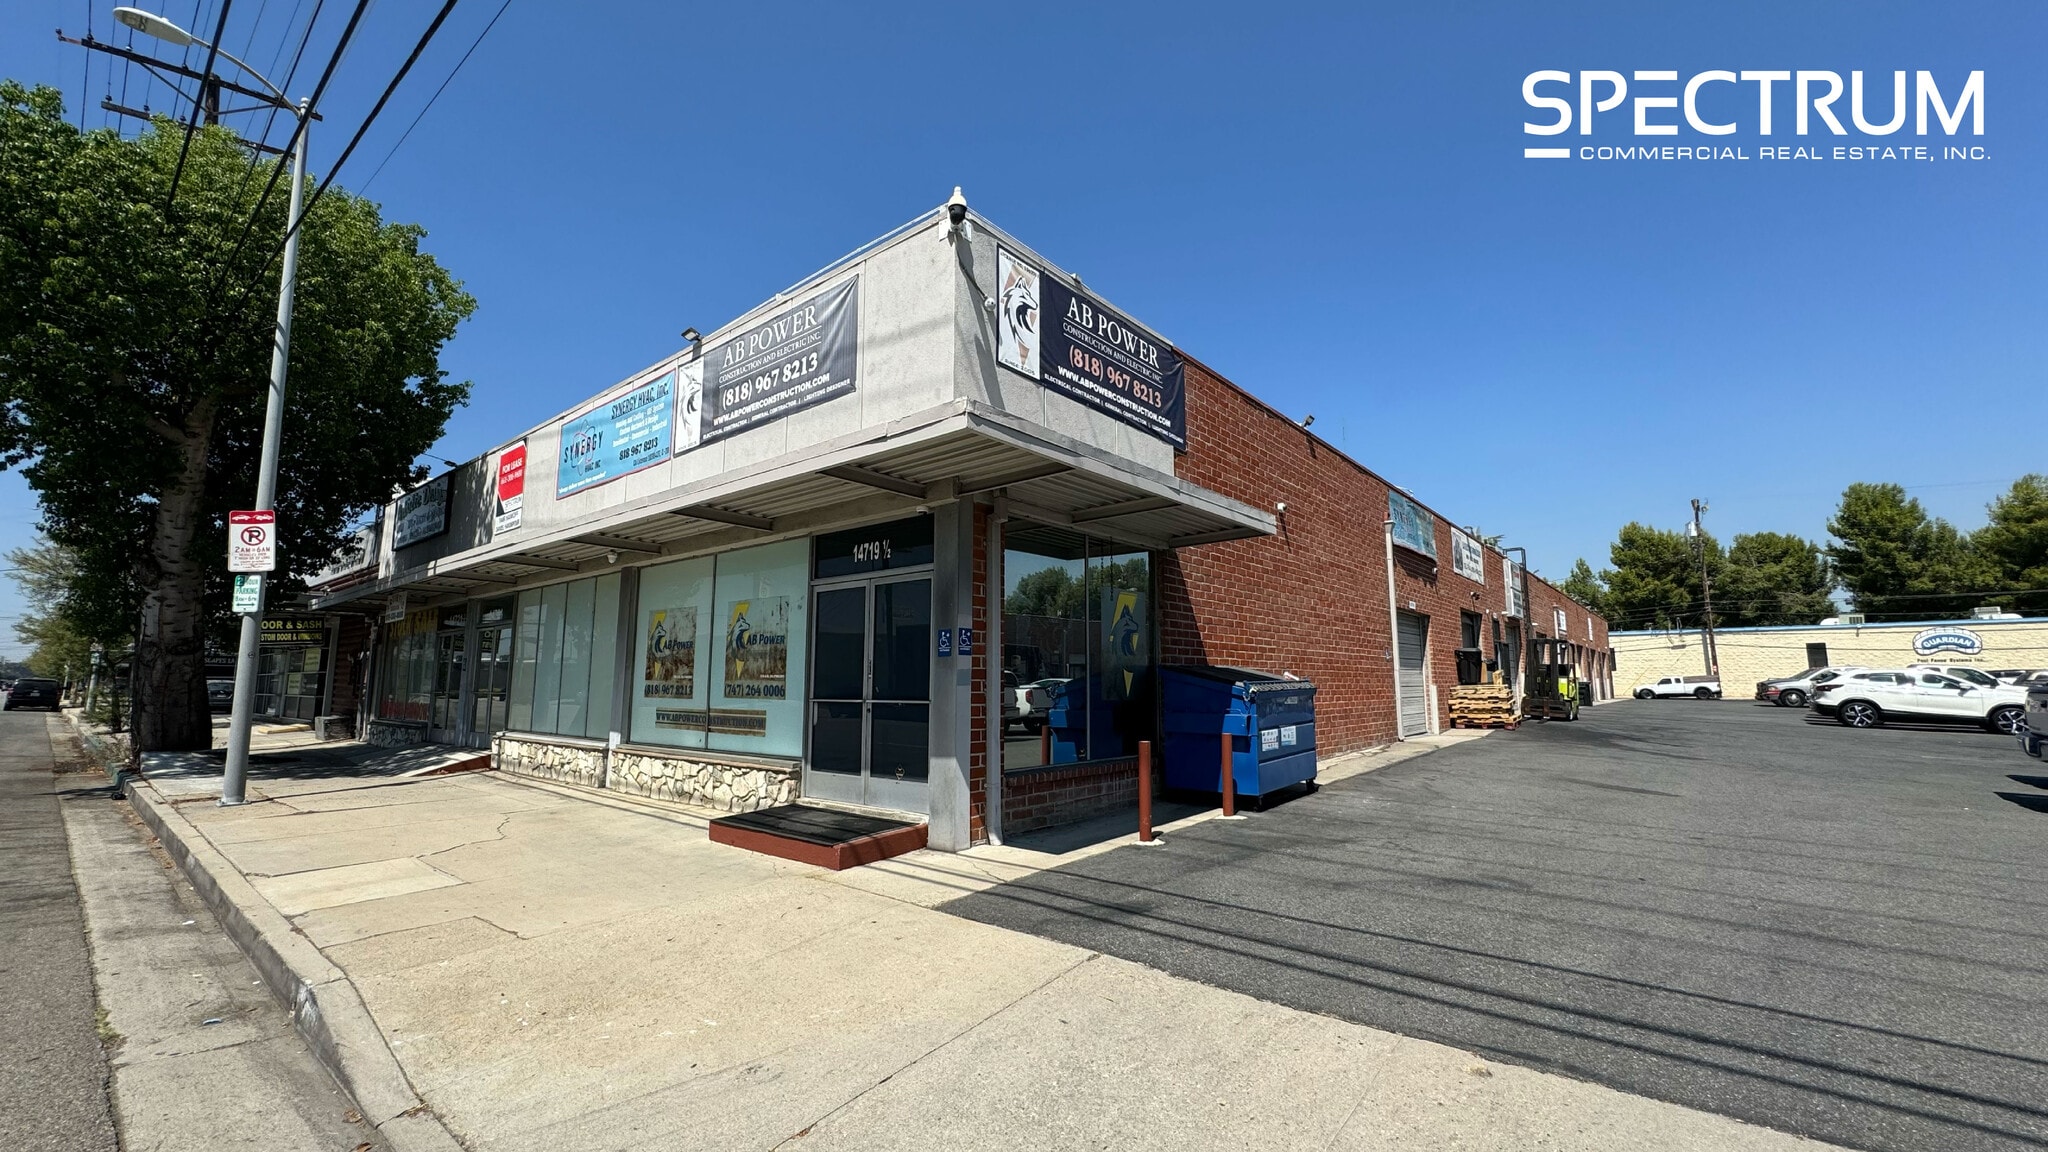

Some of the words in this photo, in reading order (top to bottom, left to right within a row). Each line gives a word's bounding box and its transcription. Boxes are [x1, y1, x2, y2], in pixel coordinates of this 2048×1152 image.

[723, 338, 744, 369] AB
[749, 304, 816, 356] POWER
[1067, 293, 1092, 330] AB
[1099, 315, 1158, 369] POWER
[718, 357, 761, 384] CONSTRUCTION
[762, 350, 776, 364] AND
[777, 336, 806, 357] ELECTRIC
[1063, 320, 1111, 356] CONSTRUCTION
[1113, 350, 1126, 364] AND
[1126, 357, 1151, 378] ELECTRIC
[722, 378, 752, 410] (818)
[755, 368, 778, 394] 967
[782, 351, 817, 383] 8213
[1069, 343, 1103, 382] (818)
[1107, 364, 1130, 393] 967
[1133, 378, 1161, 409] 8213
[611, 394, 637, 420] SYNERGY
[713, 372, 829, 426] WWW.ABPOWERCONSTRUCTION.COM
[1058, 364, 1170, 428] WWW.ABPOWERCONSTRUCTION.COM
[1072, 386, 1099, 404] CONTRACTOR
[564, 431, 603, 463] SYNERGY
[619, 447, 630, 460] 818
[630, 442, 642, 456] 967
[643, 436, 658, 451] 8213
[502, 463, 510, 474] FOR
[510, 456, 522, 470] LEASE
[853, 541, 880, 562] 14719
[261, 620, 283, 629] OOR
[286, 620, 293, 629] &
[296, 620, 322, 629] SASH
[663, 640, 673, 649] AB
[673, 640, 693, 649] POWER
[746, 635, 757, 645] AB
[759, 634, 785, 645] POWER
[1923, 637, 1972, 648] GUARDIAN
[645, 684, 660, 695] (818)
[662, 684, 674, 695] 967
[675, 685, 693, 695] 8213
[724, 684, 744, 696] (747)
[746, 685, 761, 696] 264
[763, 685, 785, 697] 0006
